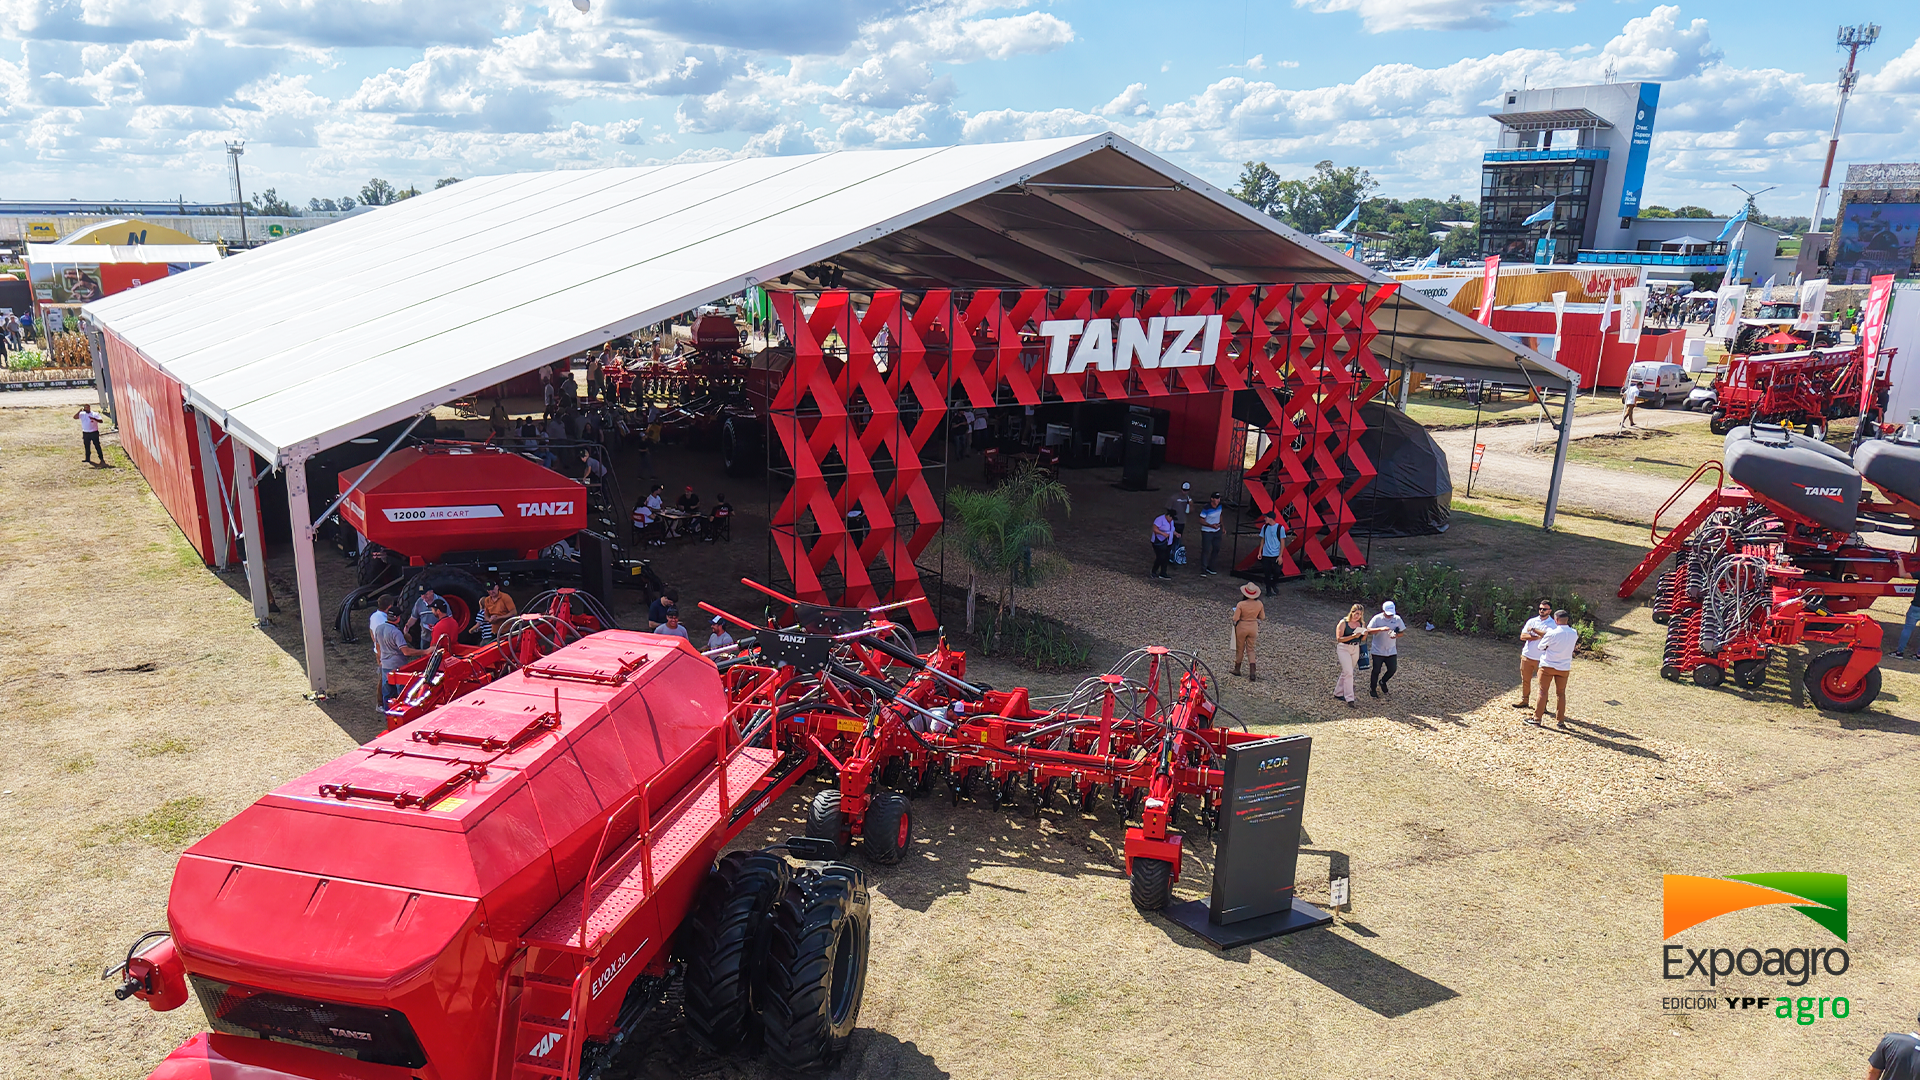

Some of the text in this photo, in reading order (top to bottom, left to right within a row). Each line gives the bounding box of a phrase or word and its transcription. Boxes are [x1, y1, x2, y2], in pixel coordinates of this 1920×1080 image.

[1039, 314, 1223, 375] TANZI
[1804, 486, 1843, 496] TANZI
[393, 511, 426, 520] 12000
[447, 510, 469, 518] CART
[517, 502, 574, 517] TANZI
[778, 635, 806, 644] TANZI
[1260, 756, 1289, 771] AZOR
[592, 952, 626, 996] EVOX 20
[329, 1027, 372, 1041] TANZI
